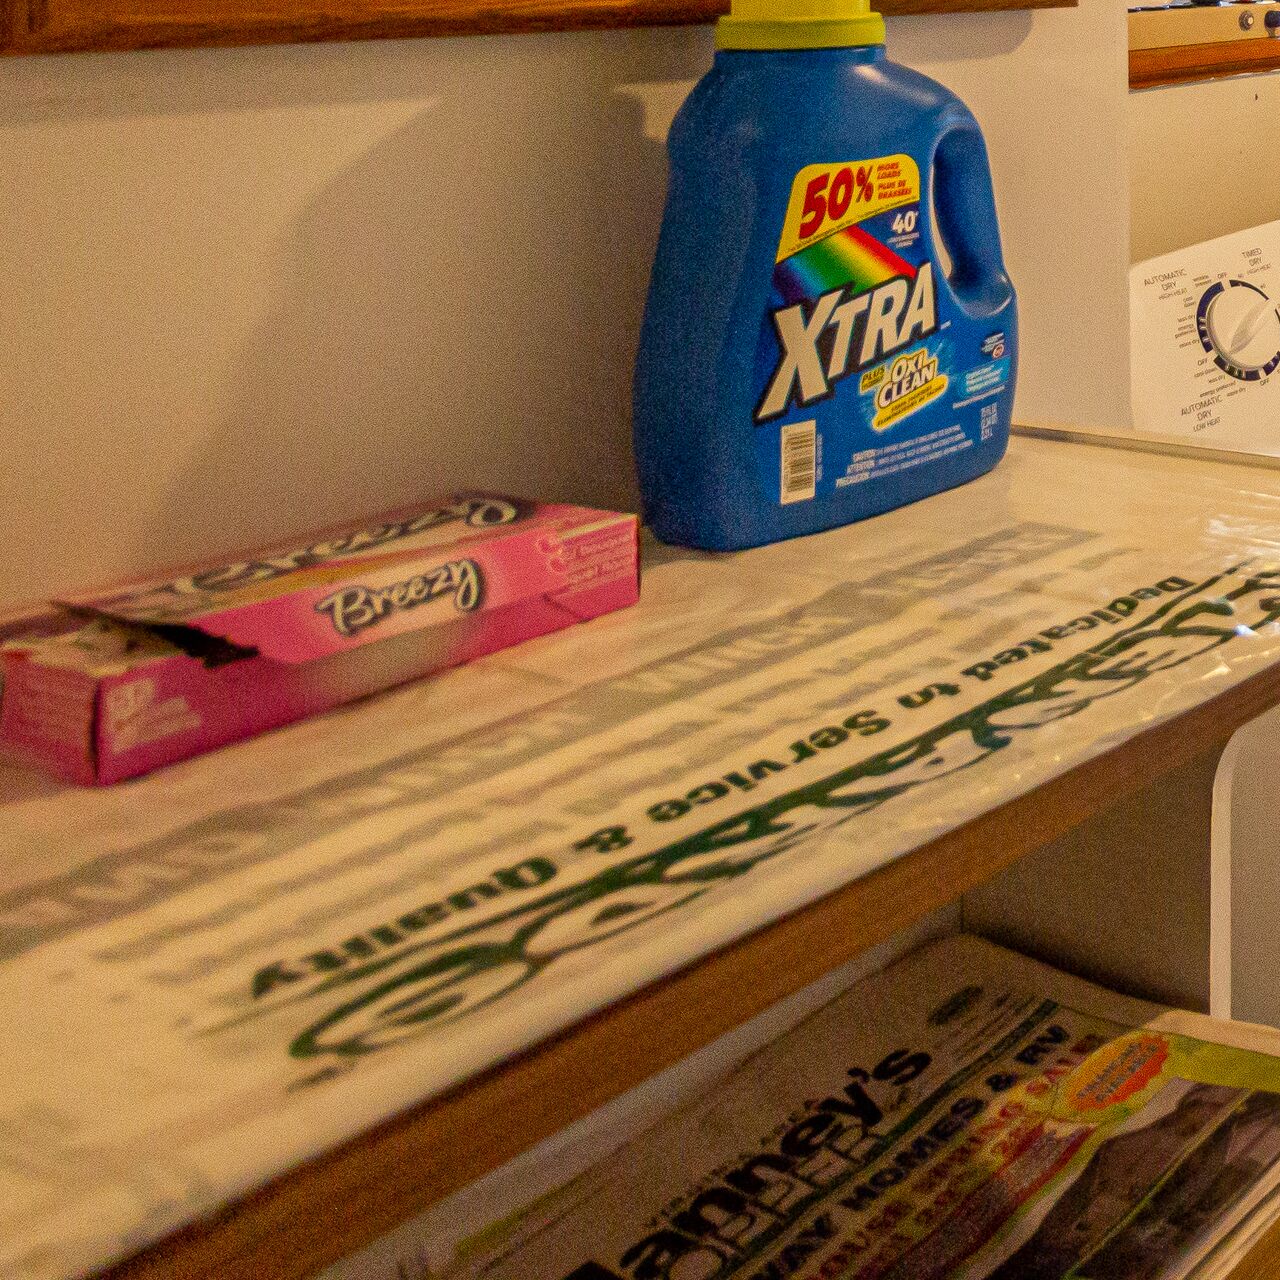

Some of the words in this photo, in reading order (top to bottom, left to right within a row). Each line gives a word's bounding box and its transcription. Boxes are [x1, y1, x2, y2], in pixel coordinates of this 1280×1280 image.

[800, 164, 873, 239] 50%
[1241, 247, 1262, 259] TIMED
[1249, 257, 1263, 267] DRY
[1143, 268, 1187, 287] AUTOMATIC
[1161, 280, 1178, 291] DRY
[757, 265, 937, 420] XTRA
[878, 360, 935, 408] CLEAN
[892, 351, 924, 382] OXI
[1181, 394, 1223, 416] AUTOMATIC
[1196, 409, 1212, 420] DRY
[314, 558, 483, 636] Breezy
[961, 575, 1198, 682] Dedicated
[897, 682, 962, 710] to
[645, 709, 892, 823] Service
[573, 824, 635, 854] &
[251, 856, 558, 1001] Quality
[839, 1096, 984, 1210] HOMES
[1014, 1024, 1070, 1066] RV
[562, 1048, 932, 1280] anney's
